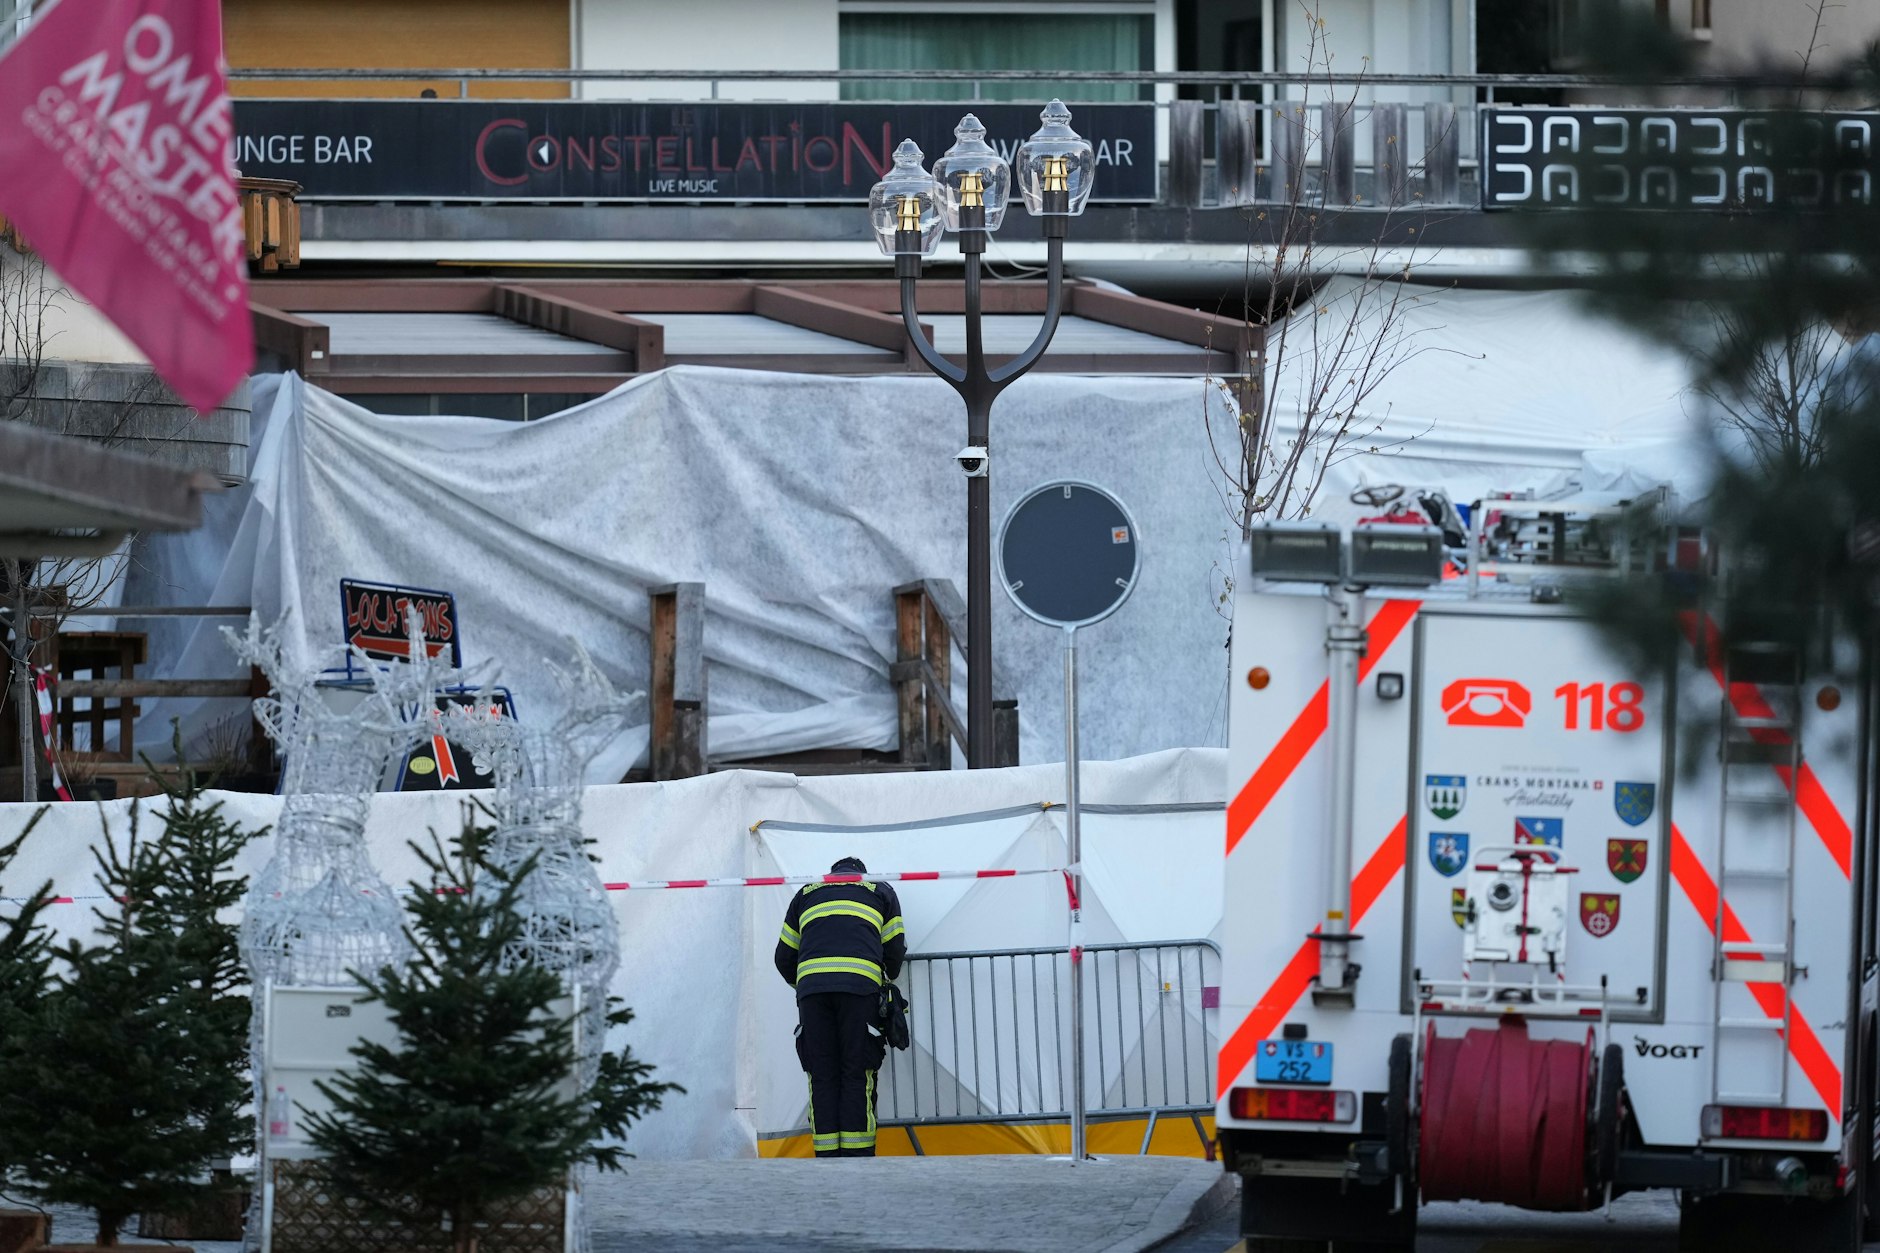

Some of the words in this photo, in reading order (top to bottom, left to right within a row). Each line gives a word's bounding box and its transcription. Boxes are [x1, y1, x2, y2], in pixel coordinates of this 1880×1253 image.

[314, 135, 373, 163] BAR
[1081, 138, 1133, 166] AR
[649, 179, 676, 193] LIVE
[678, 179, 719, 193] MUSIC
[345, 589, 454, 640] LOCATONS
[1554, 681, 1645, 733] 118
[1476, 775, 1519, 787] CRANS
[1526, 778, 1589, 790] MONTANA
[1286, 1042, 1304, 1058] VS
[1634, 1035, 1705, 1059] VOGT
[1278, 1061, 1312, 1081] 252
